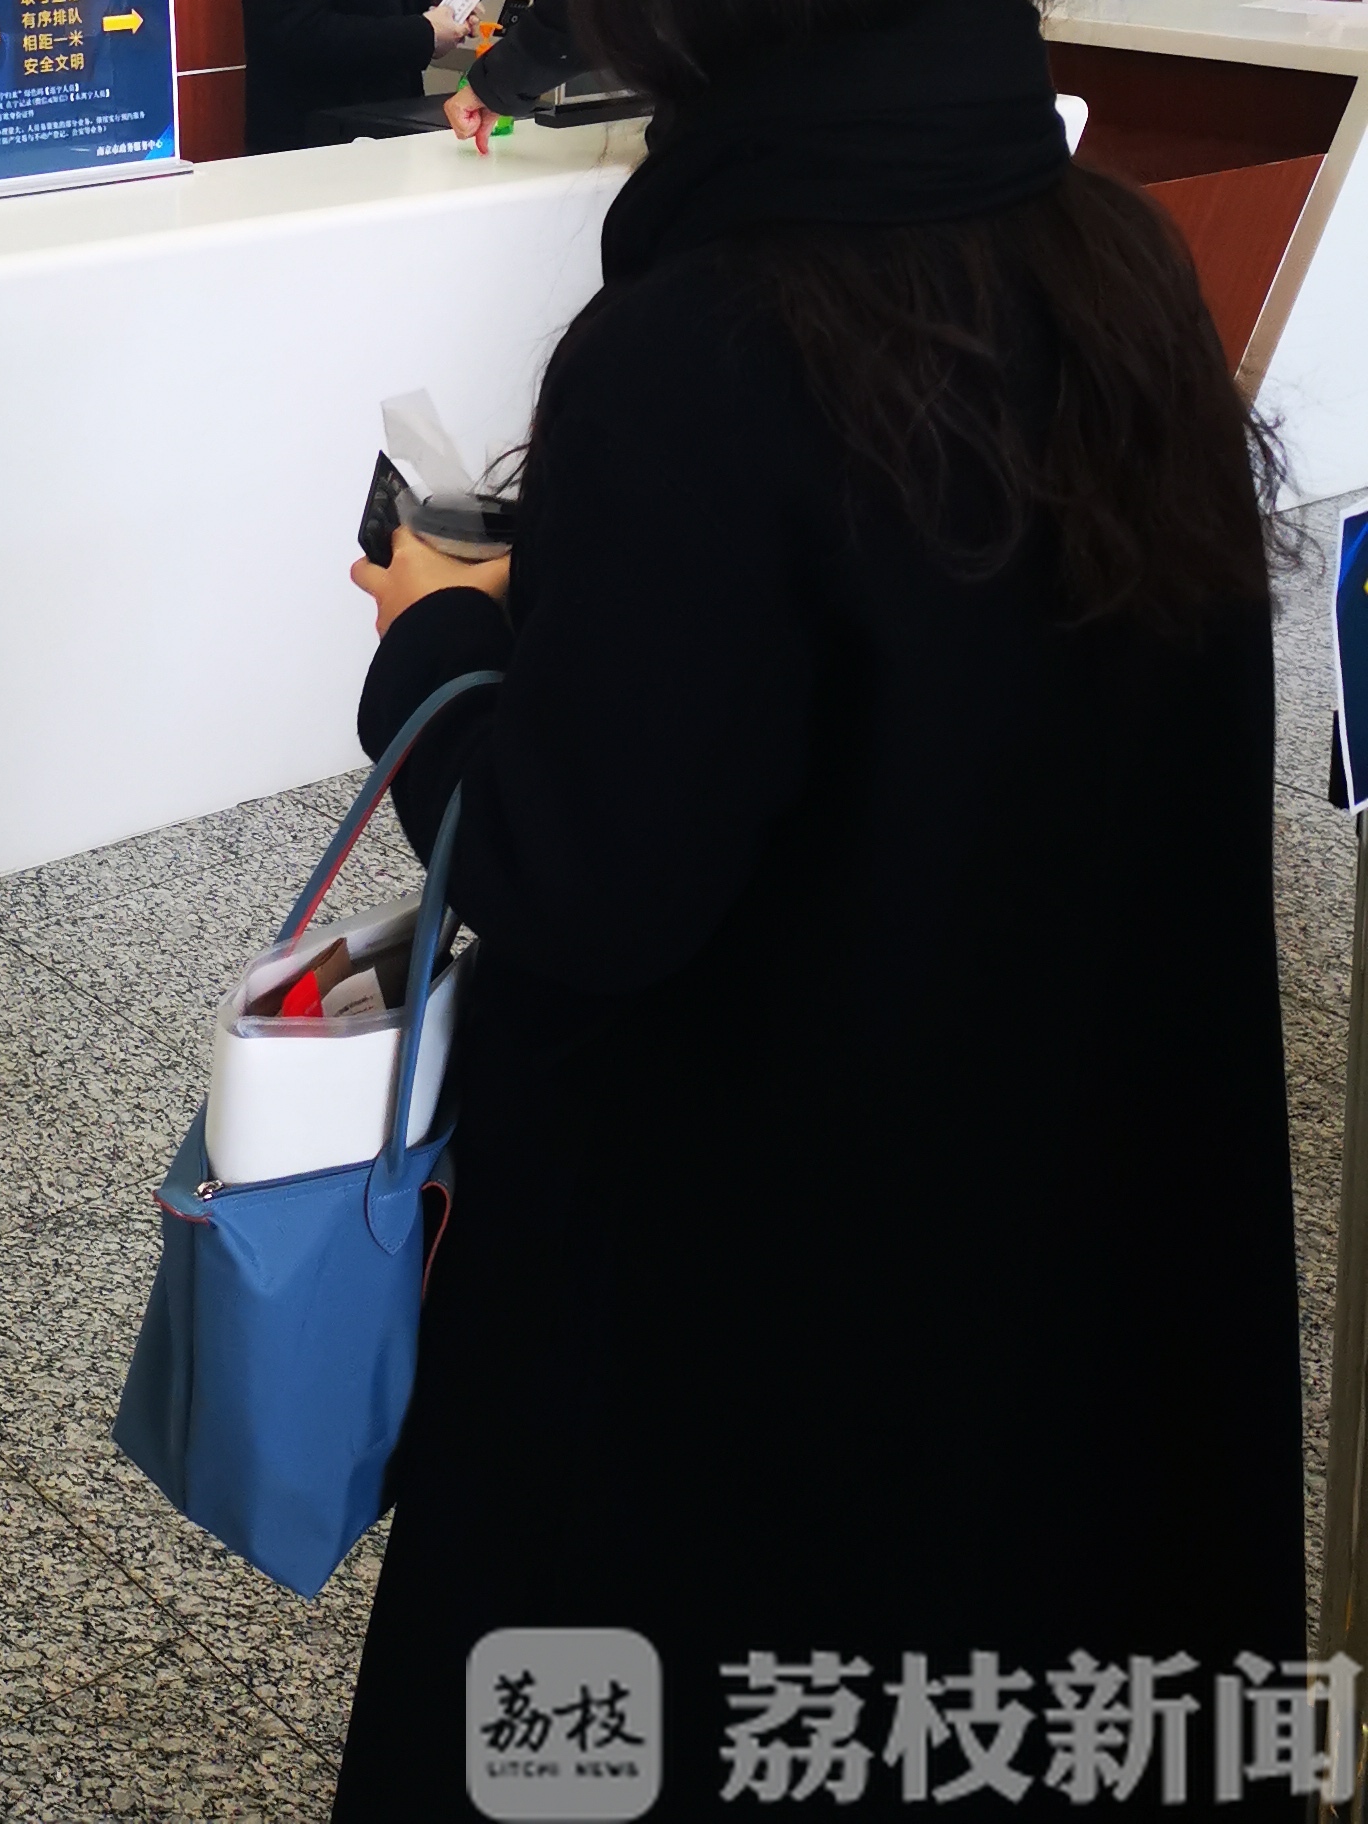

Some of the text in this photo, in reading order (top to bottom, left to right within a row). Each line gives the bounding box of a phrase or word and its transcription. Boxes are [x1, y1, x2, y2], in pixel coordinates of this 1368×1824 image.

[21, 7, 83, 29] 有序排队
[22, 29, 84, 52] 相距一米
[23, 52, 85, 76] 安全文明
